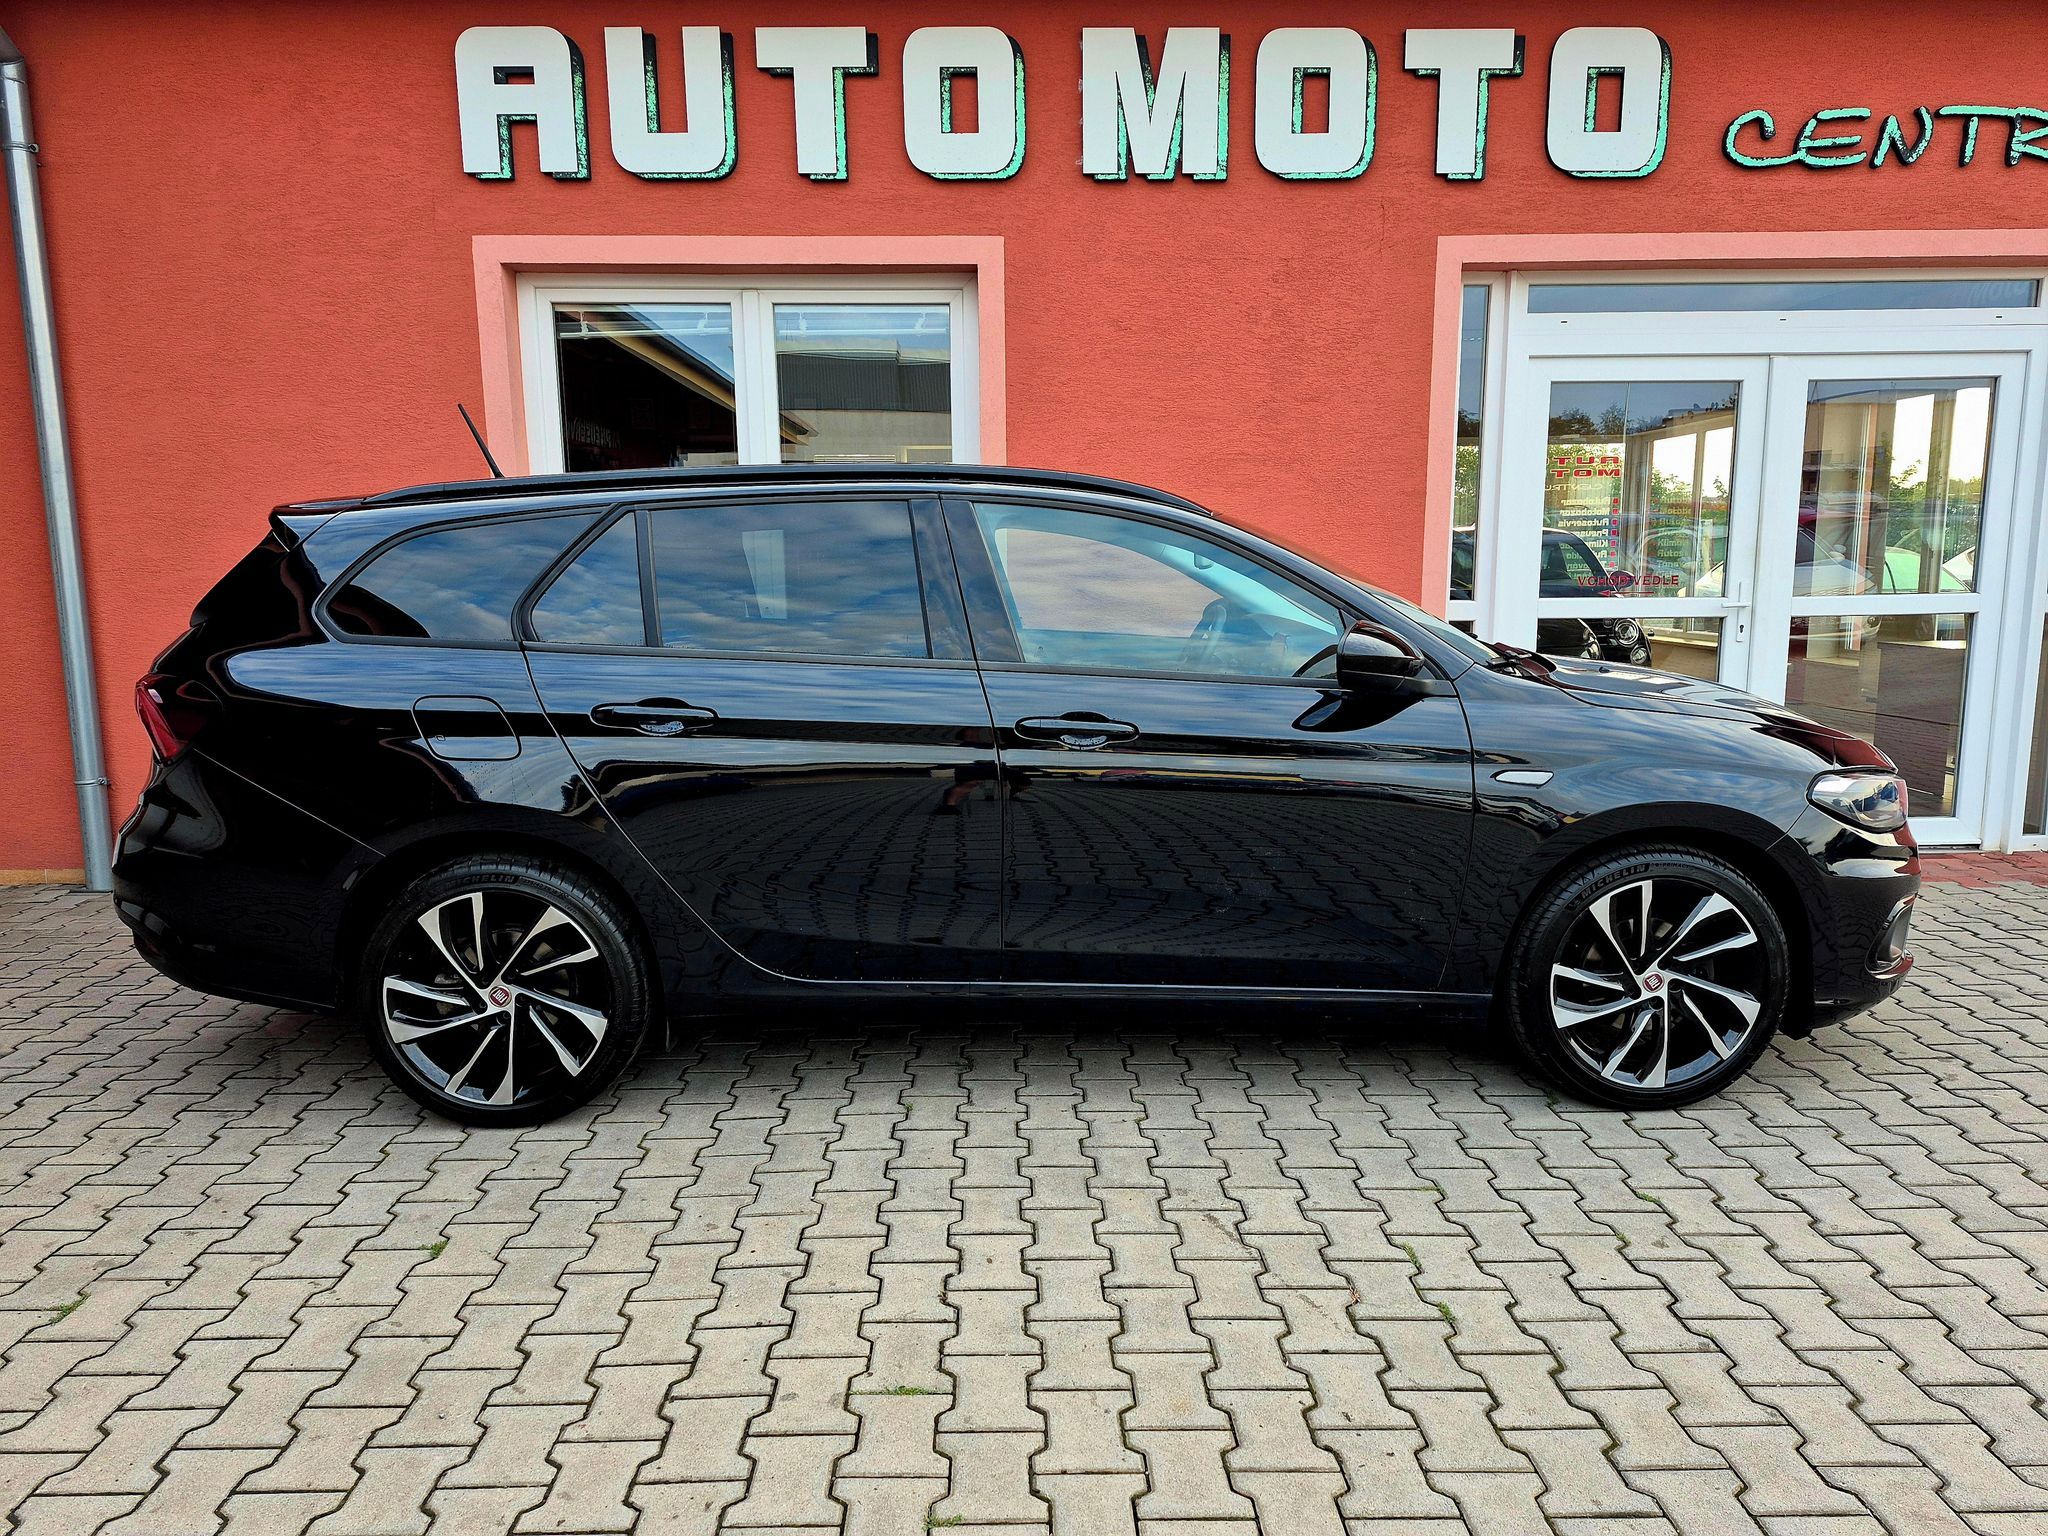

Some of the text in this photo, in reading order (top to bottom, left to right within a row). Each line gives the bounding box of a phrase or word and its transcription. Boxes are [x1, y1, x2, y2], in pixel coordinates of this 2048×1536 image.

[454, 25, 1026, 182] AUTO
[1081, 26, 1672, 182] MOTO
[1577, 575, 1629, 586] VCHOD
[1633, 574, 1680, 587] VEDLE
[1581, 864, 1646, 899] MICHELIN
